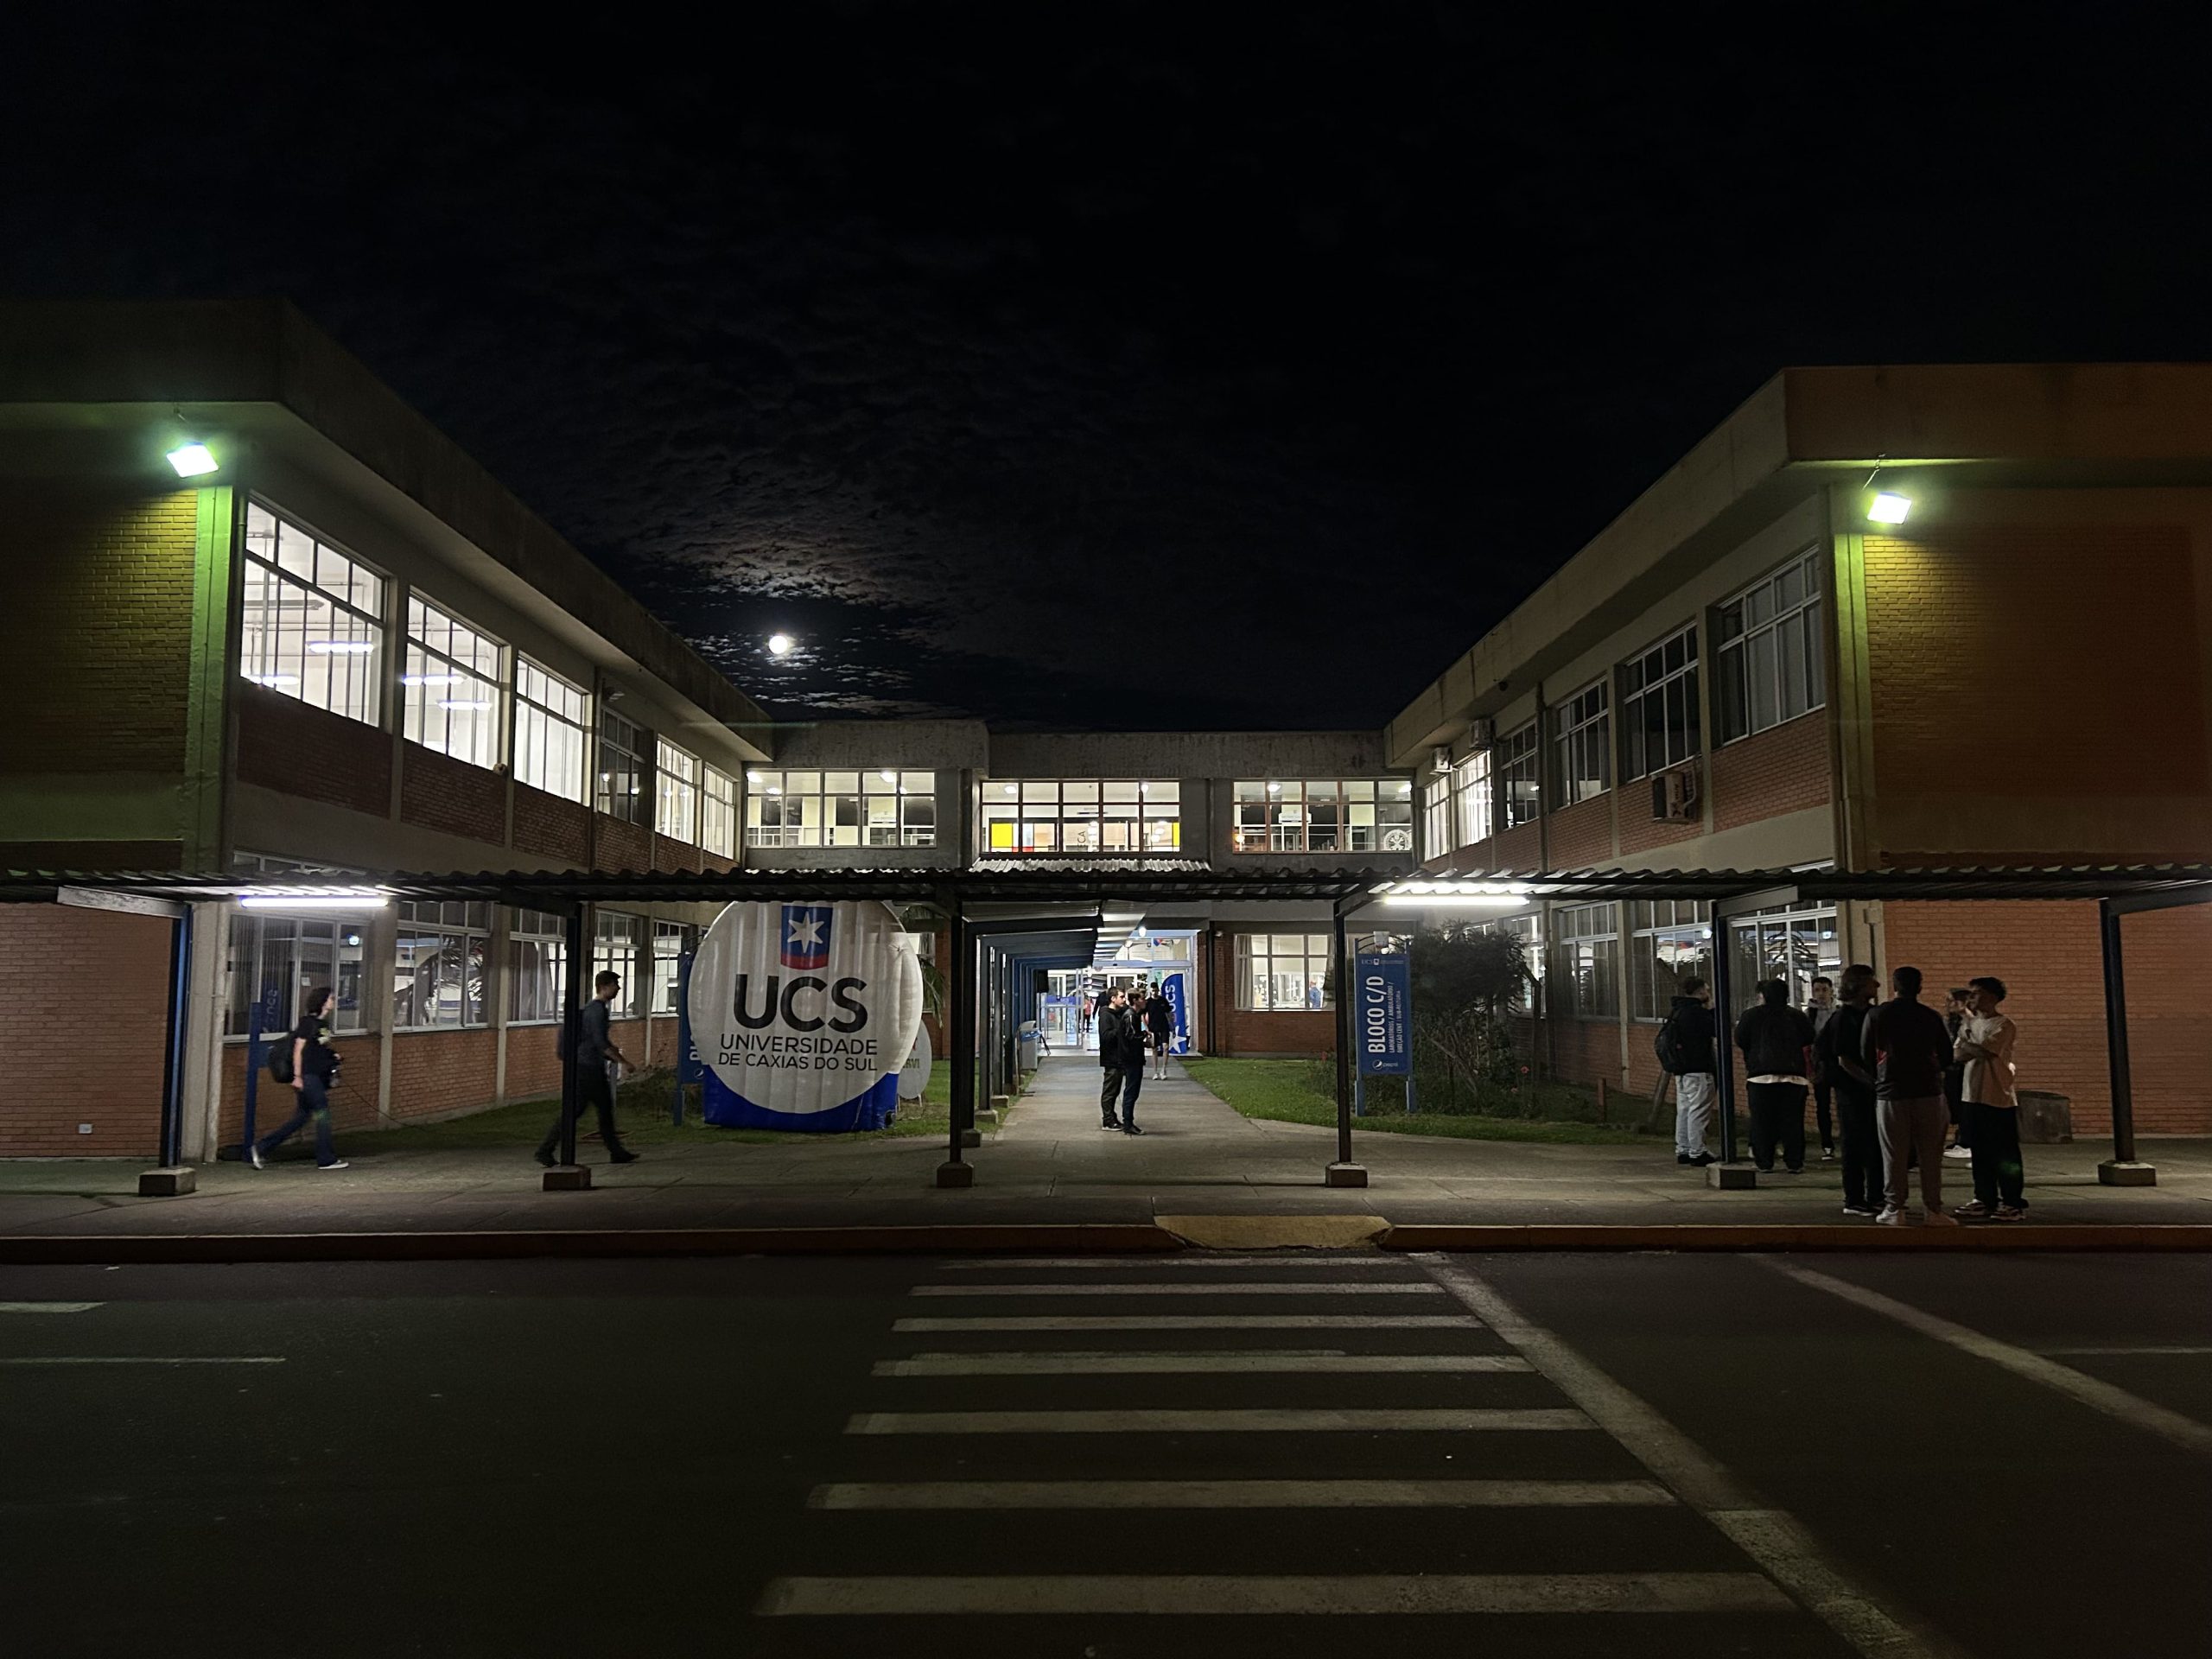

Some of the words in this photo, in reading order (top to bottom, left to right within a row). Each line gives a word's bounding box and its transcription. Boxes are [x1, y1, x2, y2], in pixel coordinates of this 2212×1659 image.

[1366, 976, 1387, 1002] C/D
[734, 974, 868, 1033] UCS
[1368, 1007, 1386, 1052] BLOCO
[721, 1033, 877, 1055] UNIVERSIDADE
[719, 1052, 741, 1065] DE
[746, 1054, 809, 1069] CAXIAS
[815, 1058, 839, 1070] DO
[845, 1058, 877, 1071] SUL
